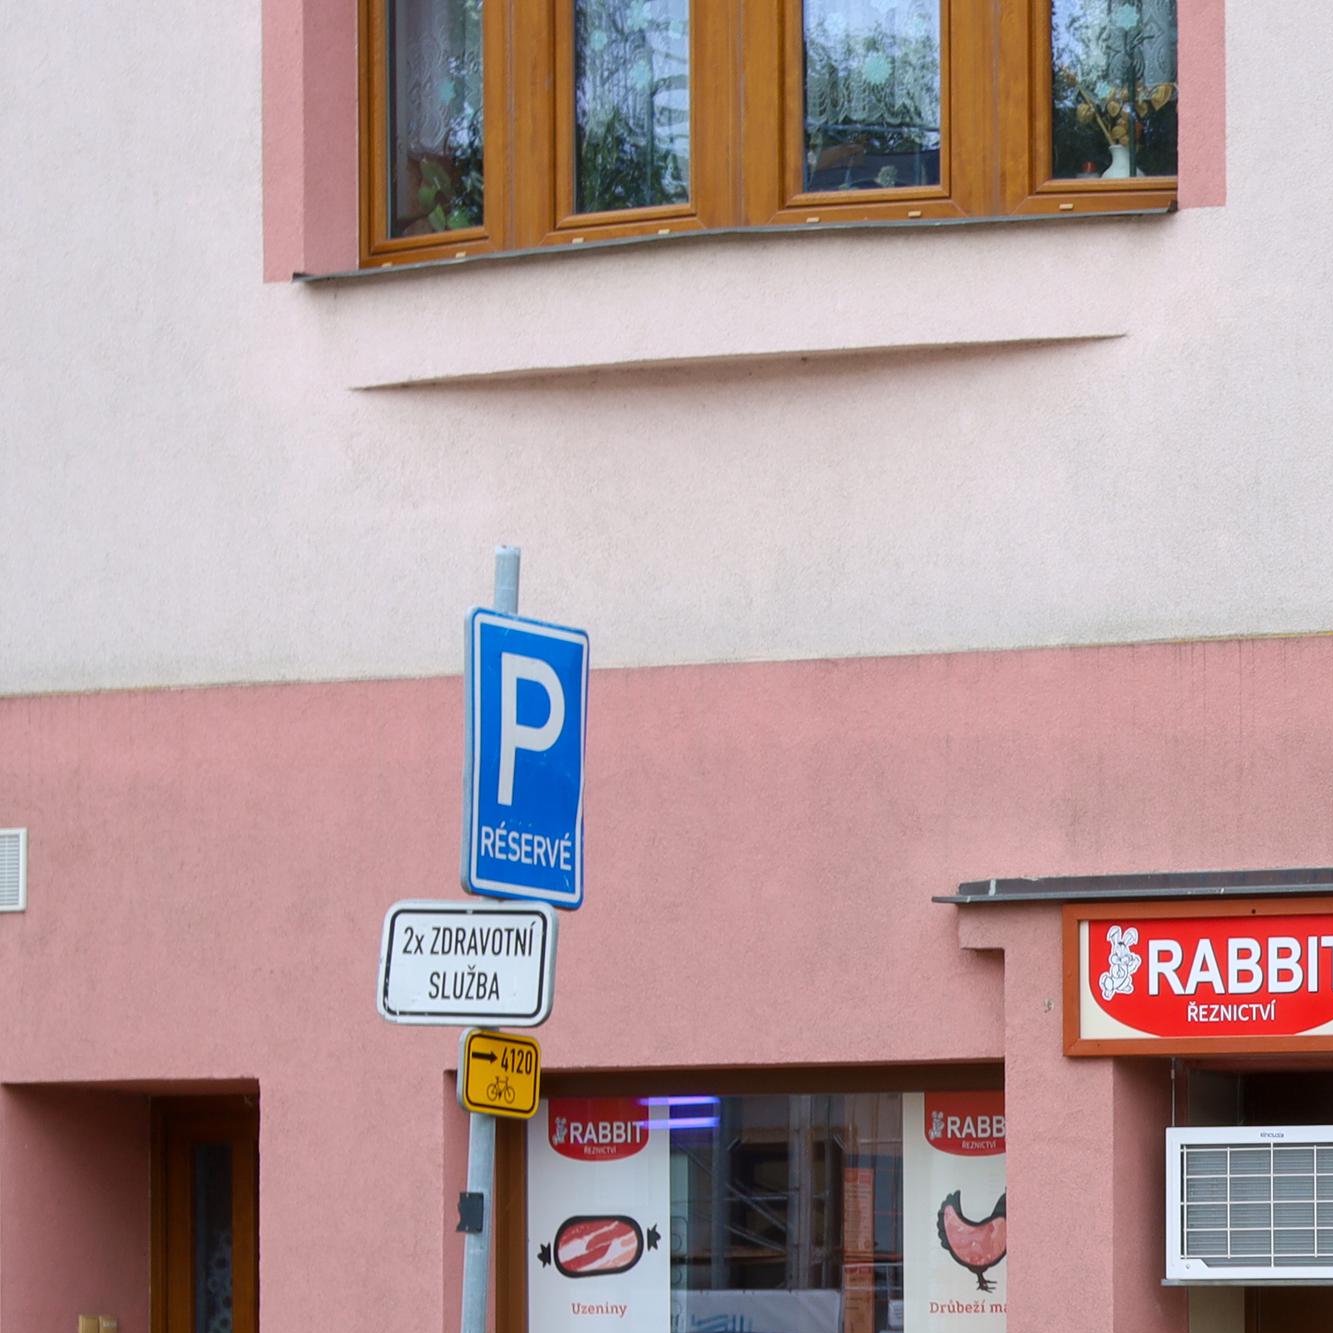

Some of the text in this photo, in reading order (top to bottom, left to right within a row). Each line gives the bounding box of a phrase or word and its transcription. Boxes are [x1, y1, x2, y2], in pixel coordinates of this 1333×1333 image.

[498, 652, 565, 805] P
[481, 822, 572, 871] RÉSERVÉ
[402, 921, 536, 956] 2x ZDRAVOTNÍ
[428, 965, 500, 1000] SLUŽBA
[1186, 999, 1276, 1022] ŘEZNICTVÍ
[501, 1048, 532, 1074] 4120
[570, 1121, 644, 1144] RABBIT
[947, 1115, 1006, 1138] RABB
[571, 1303, 627, 1318] Uzeniny
[930, 1300, 985, 1314] Drůbeží
